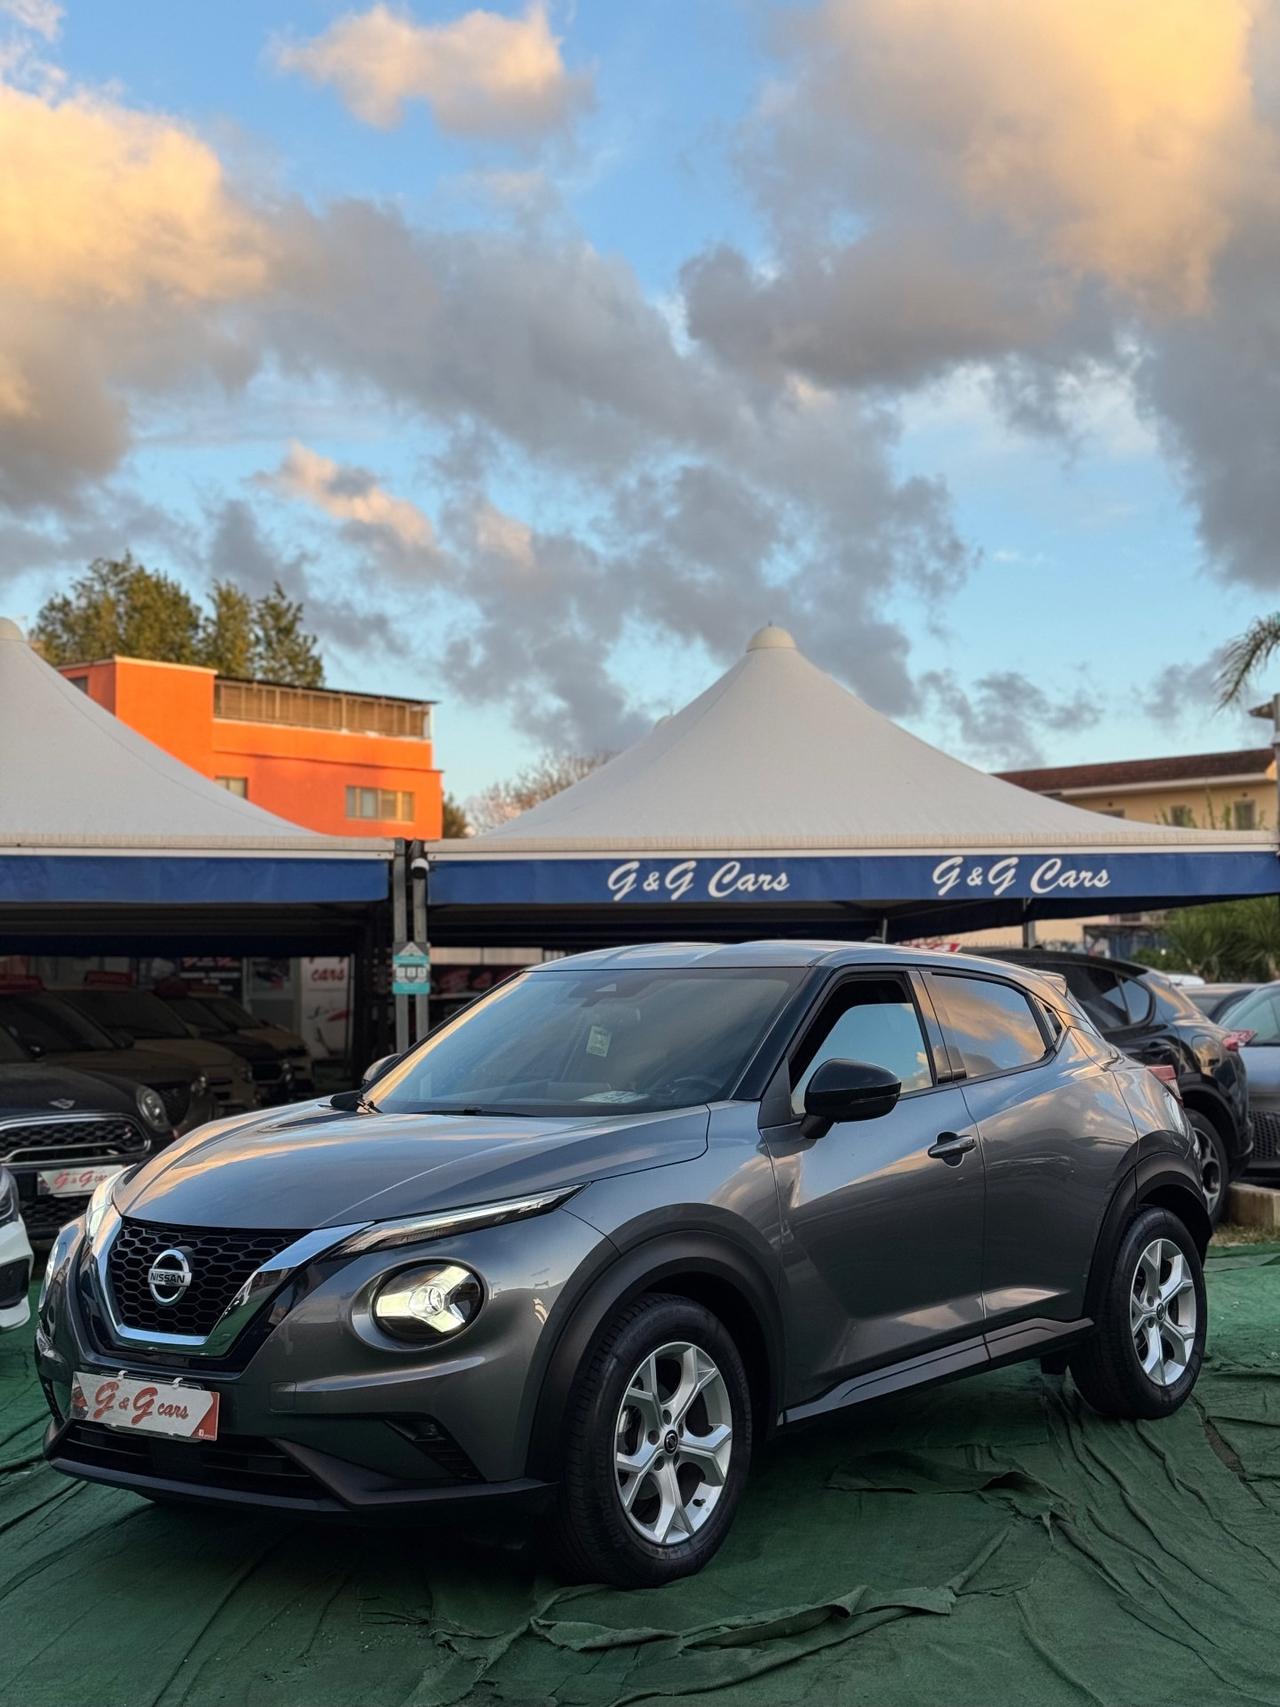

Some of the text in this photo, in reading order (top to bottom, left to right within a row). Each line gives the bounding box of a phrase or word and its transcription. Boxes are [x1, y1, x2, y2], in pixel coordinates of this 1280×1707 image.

[708, 861, 790, 898] Cars
[1030, 858, 1111, 894] Cars
[150, 1272, 186, 1284] NISSAN
[157, 1401, 190, 1420] cars
